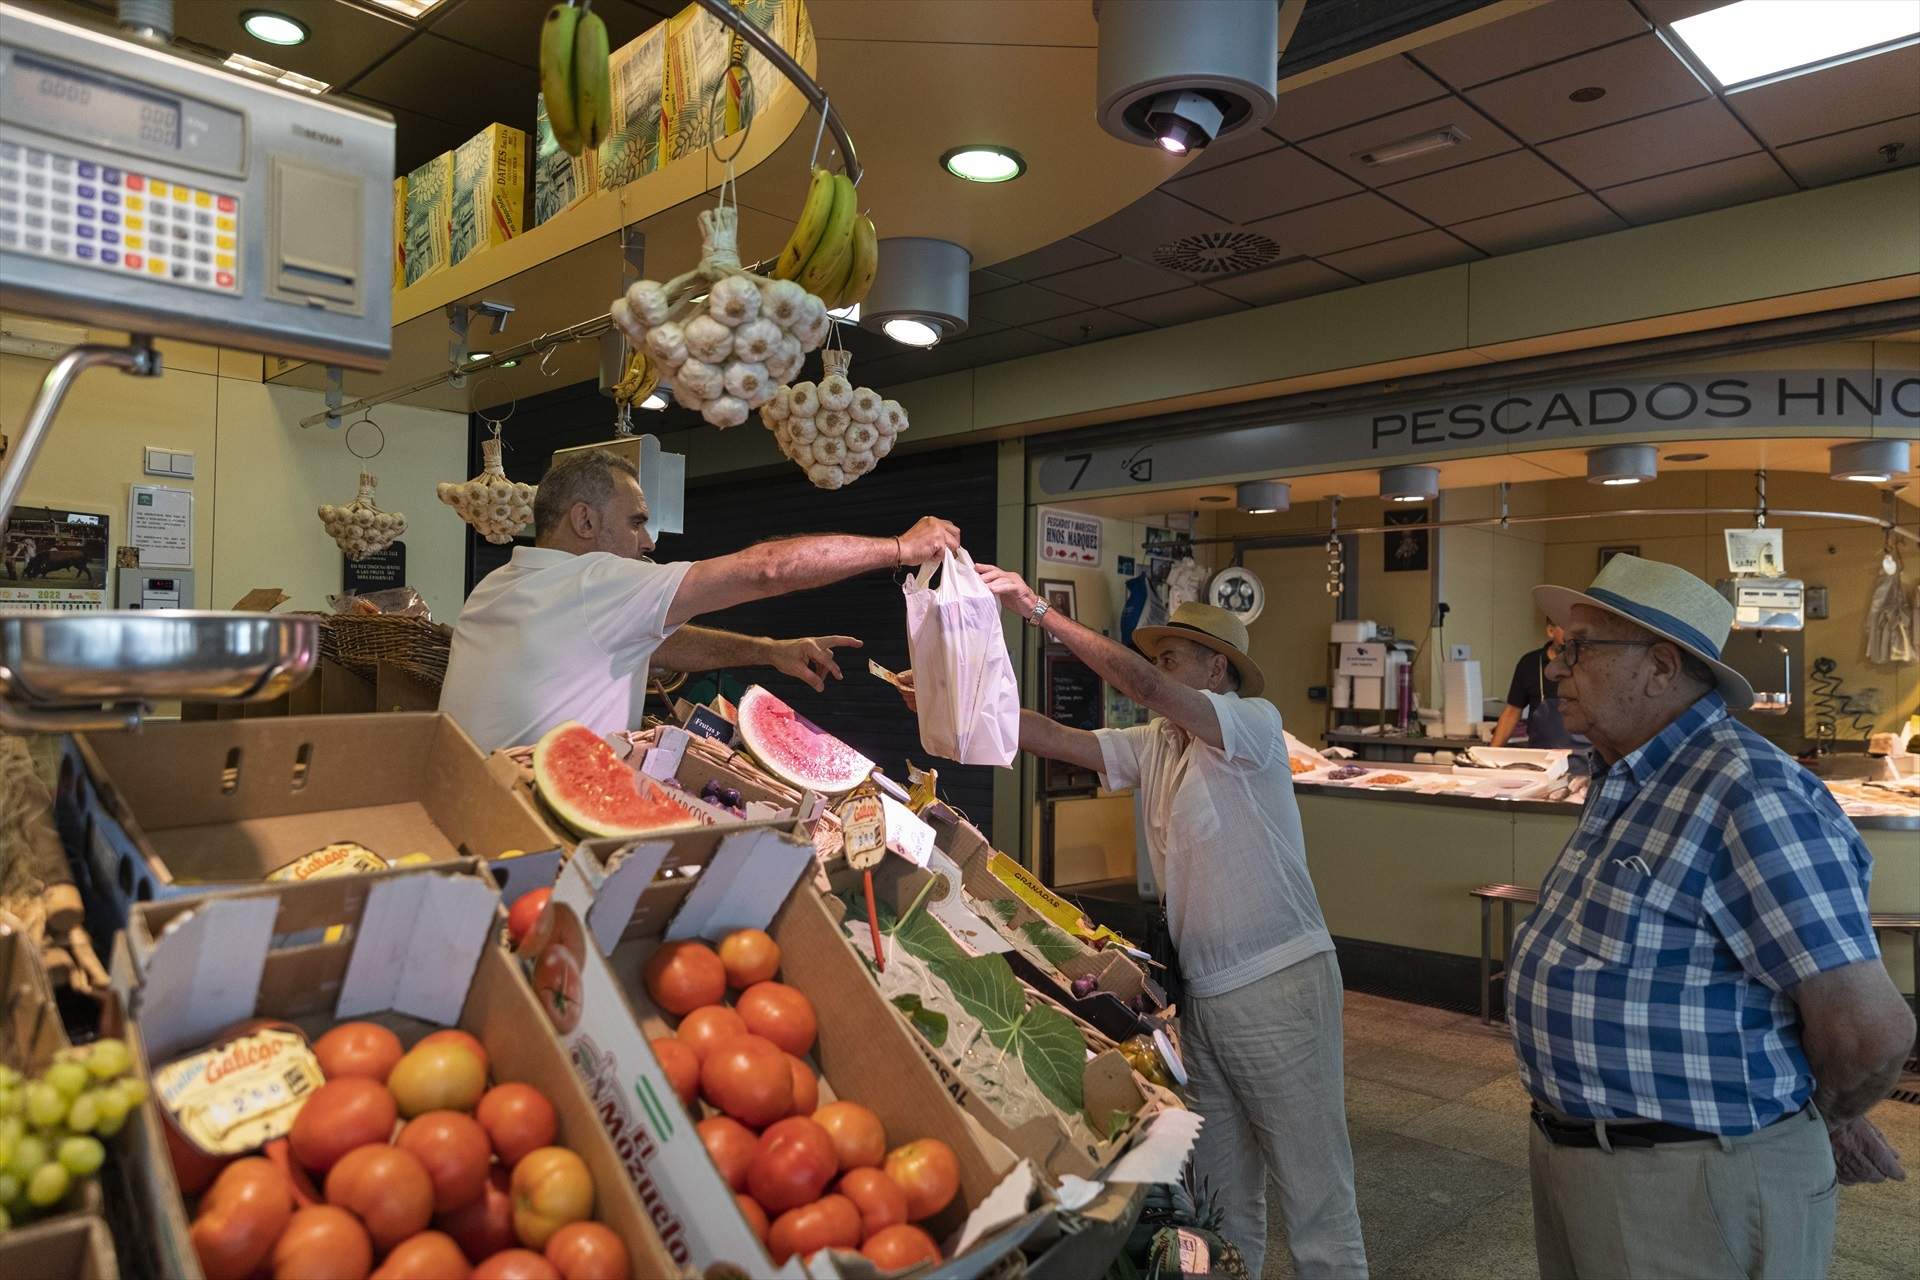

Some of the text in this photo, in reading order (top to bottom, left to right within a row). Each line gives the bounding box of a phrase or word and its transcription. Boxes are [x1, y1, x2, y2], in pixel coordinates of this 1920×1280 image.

[1371, 379, 1752, 450] PESCADOS
[1064, 453, 1093, 490] 7
[38, 590, 61, 599] 2022
[694, 717, 716, 734] Frutas
[1014, 872, 1060, 908] GRANADAS
[600, 1101, 690, 1266] Mozuelo
